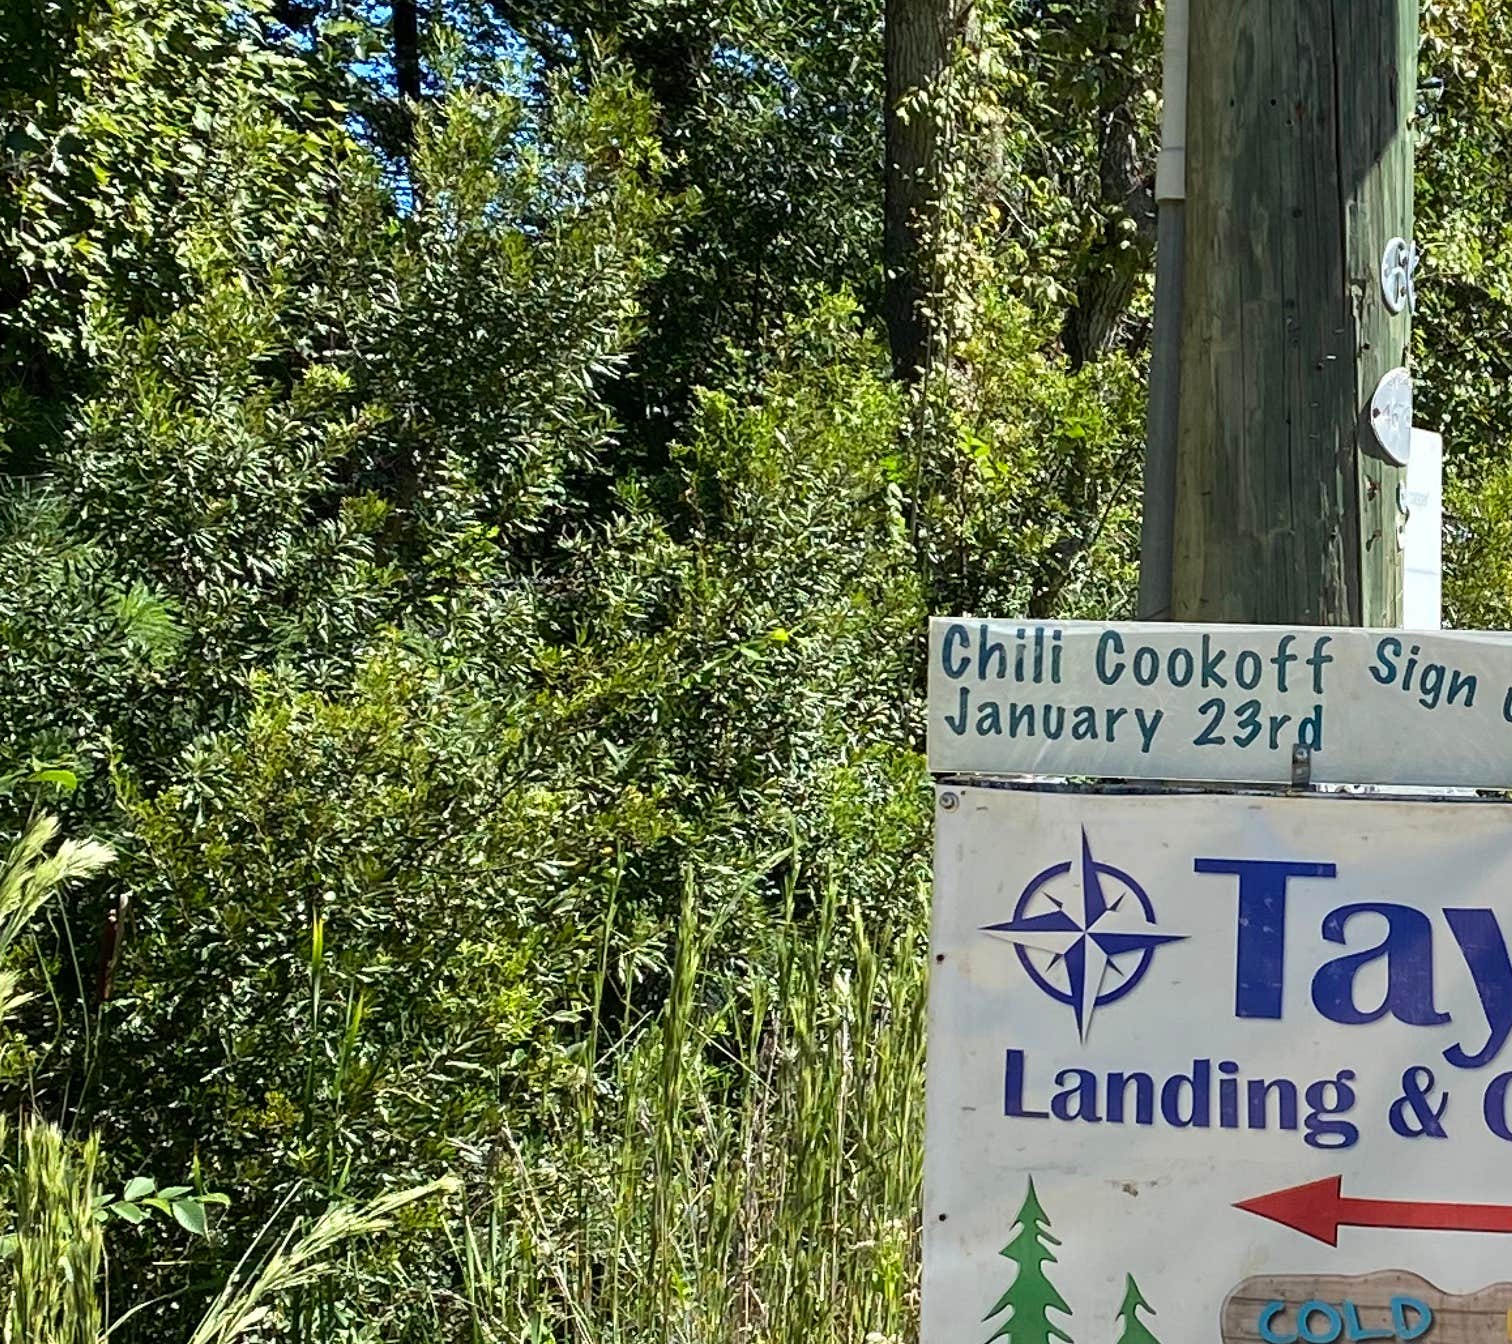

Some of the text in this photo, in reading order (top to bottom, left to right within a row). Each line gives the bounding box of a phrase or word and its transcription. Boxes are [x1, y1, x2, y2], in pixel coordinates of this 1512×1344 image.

[940, 623, 1334, 695] Chili Cookoff
[1369, 636, 1479, 711] Sign
[944, 687, 1323, 753] January 23rd
[1004, 1048, 1361, 1150] Landing
[1388, 1064, 1450, 1140] &
[1258, 1295, 1434, 1344] COLD
